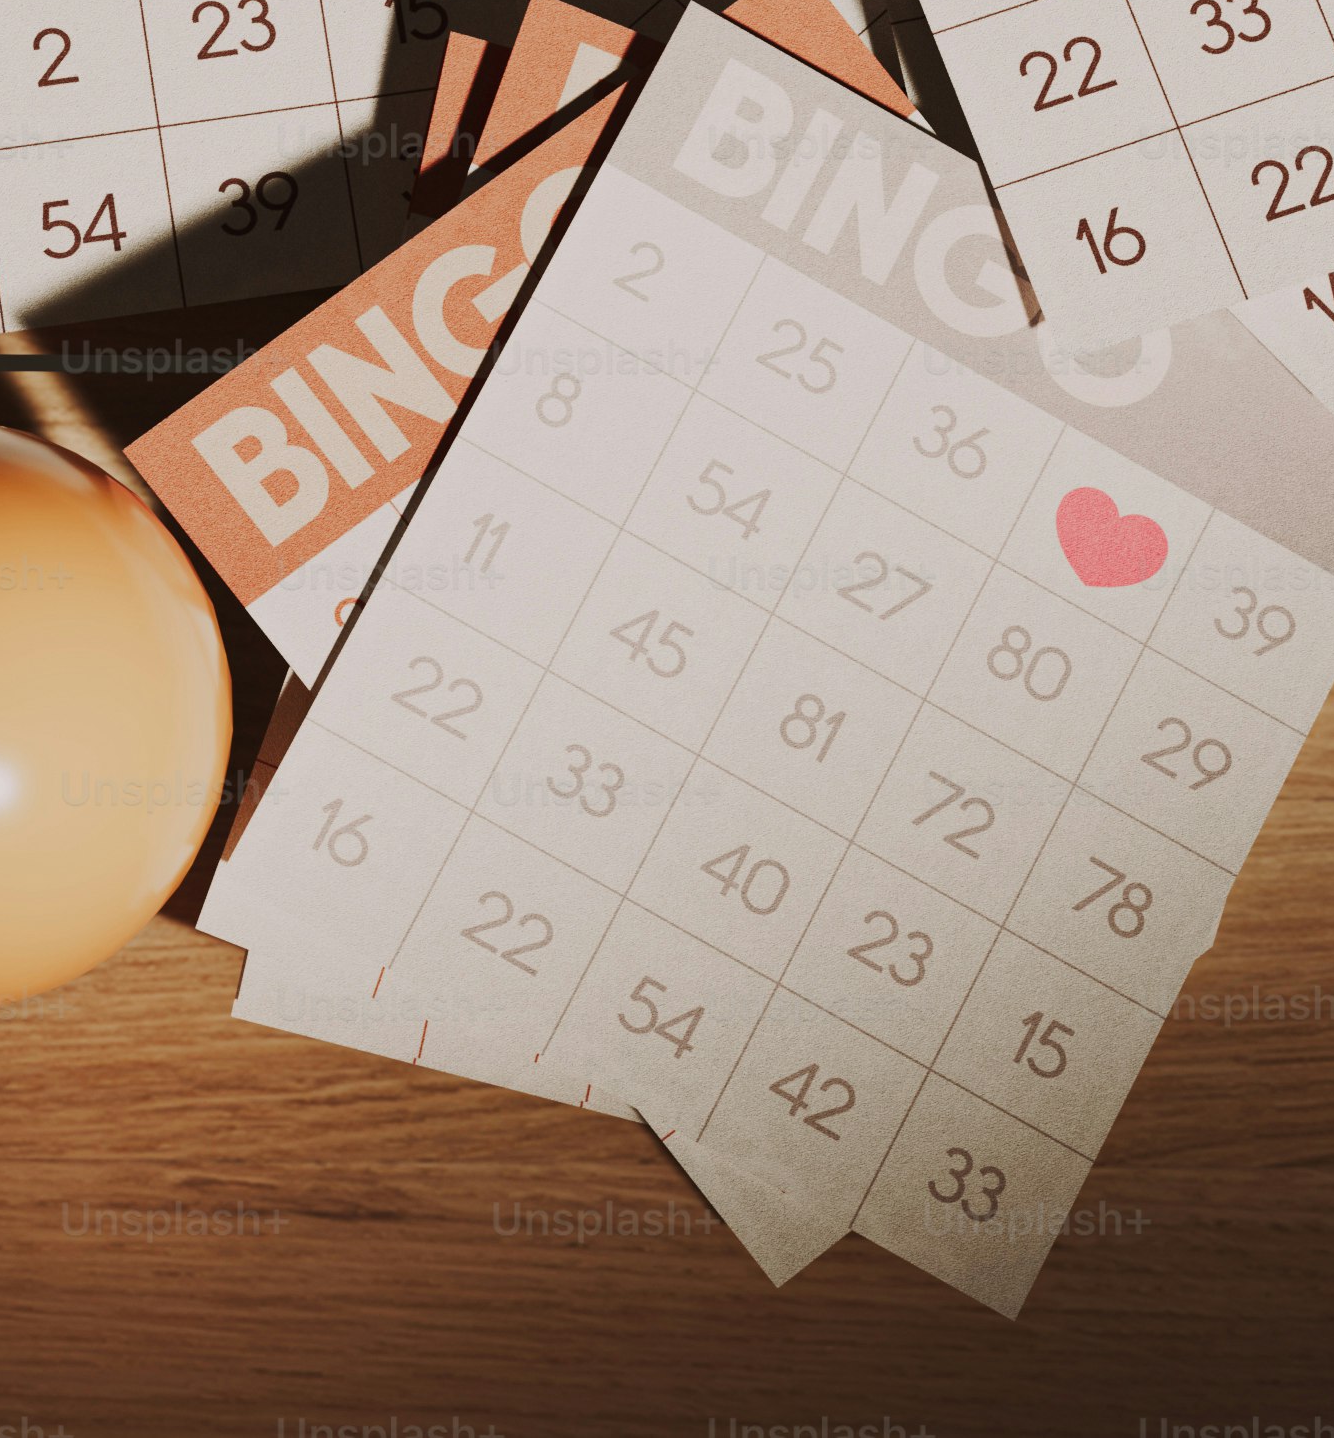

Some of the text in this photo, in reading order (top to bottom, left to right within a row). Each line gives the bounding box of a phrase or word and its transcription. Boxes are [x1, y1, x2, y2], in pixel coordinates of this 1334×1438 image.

[33, 28, 79, 87] 2
[42, 193, 126, 259] 54
[218, 173, 297, 235] 39
[1019, 36, 1117, 112] 22
[1076, 207, 1146, 274] 16
[535, 371, 1232, 790] 8 54 27 80 29
[613, 241, 1296, 657] 2 25 36 39
[391, 656, 1075, 1079] 22 33 40 23 15
[463, 513, 1153, 939] 11 45 81 72 78
[312, 798, 1006, 1223] 16 22 54 42 33
